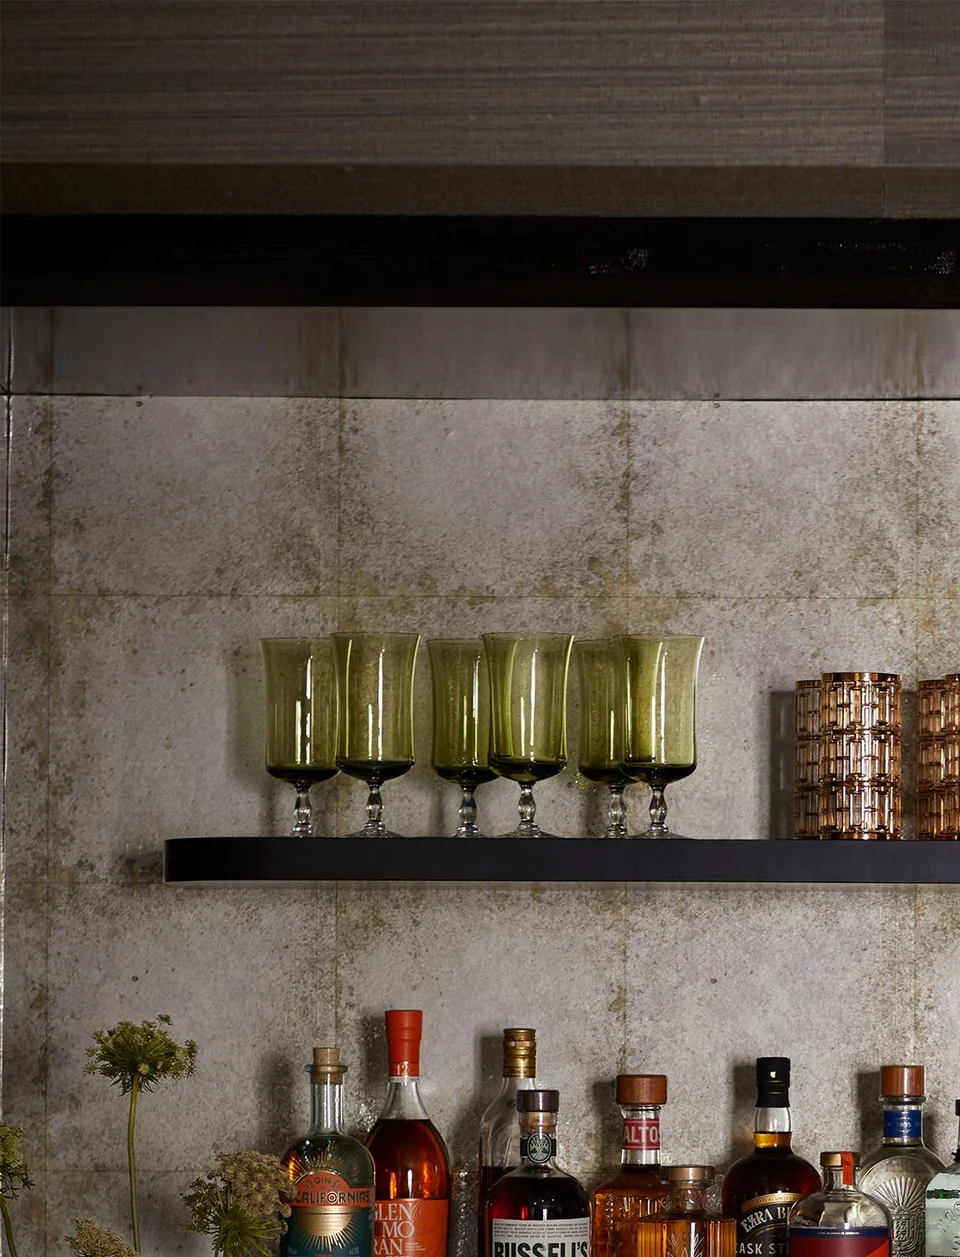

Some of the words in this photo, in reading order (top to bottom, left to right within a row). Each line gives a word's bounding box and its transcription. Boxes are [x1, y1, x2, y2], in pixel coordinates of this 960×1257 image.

[396, 1063, 410, 1076] 12
[314, 1176, 332, 1185] GIN
[740, 1208, 774, 1233] EZRA
[382, 1221, 415, 1238] MO
